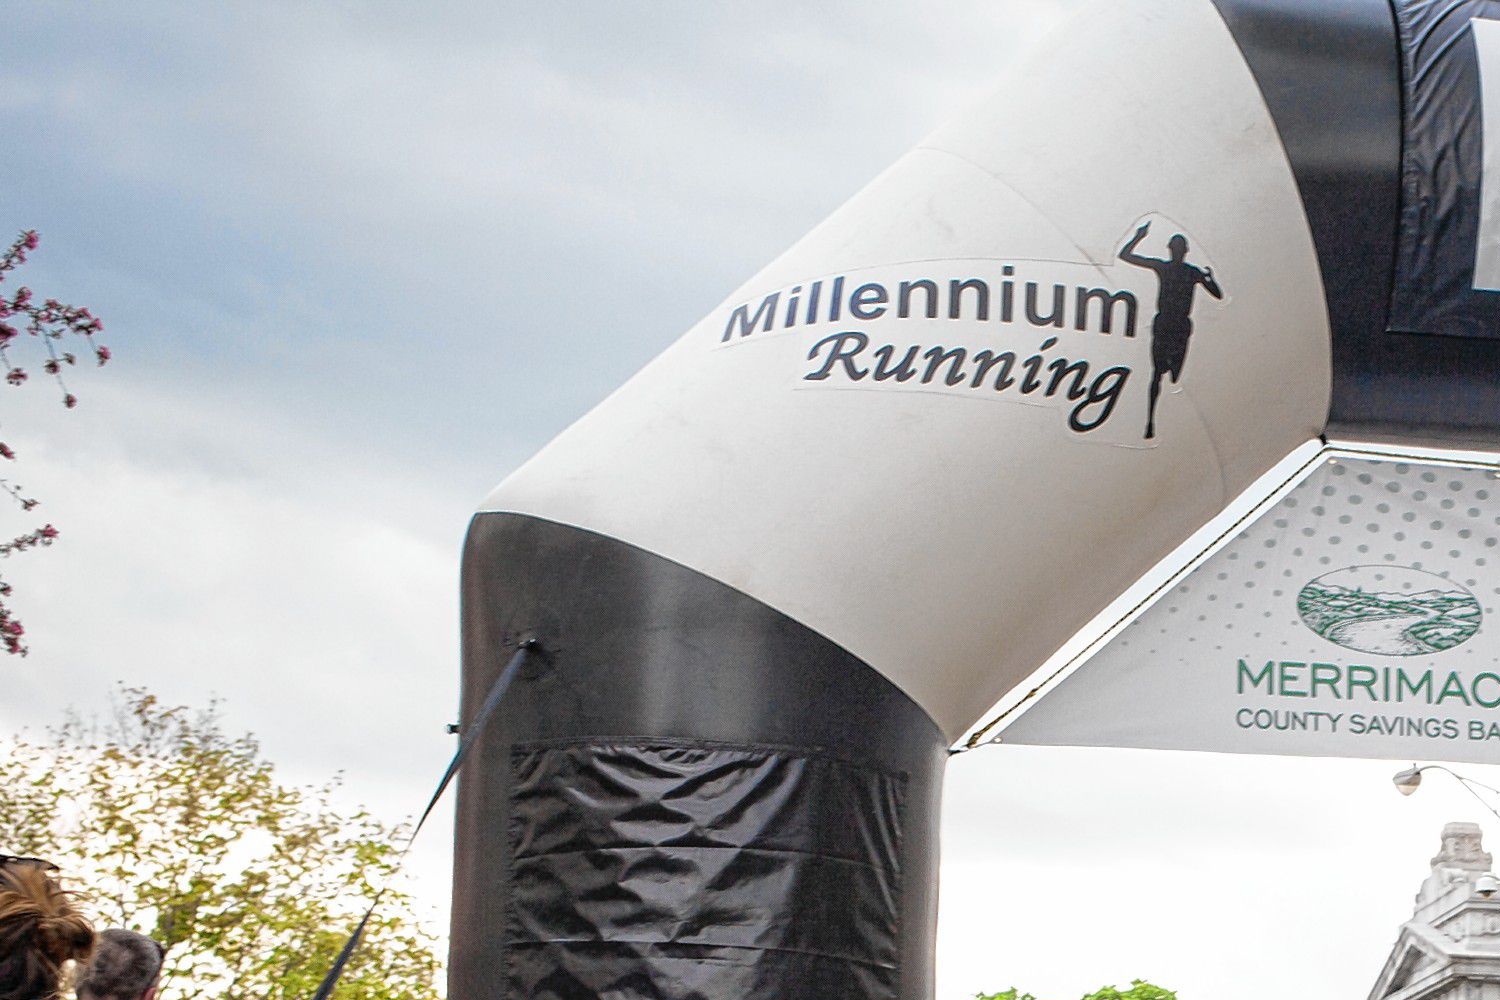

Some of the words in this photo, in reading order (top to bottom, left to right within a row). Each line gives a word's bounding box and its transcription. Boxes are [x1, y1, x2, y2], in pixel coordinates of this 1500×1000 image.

[721, 265, 1138, 342] Millennium
[803, 331, 1133, 432] Running
[1236, 708, 1344, 733] COUNTY
[1348, 713, 1459, 740] SAVINGS
